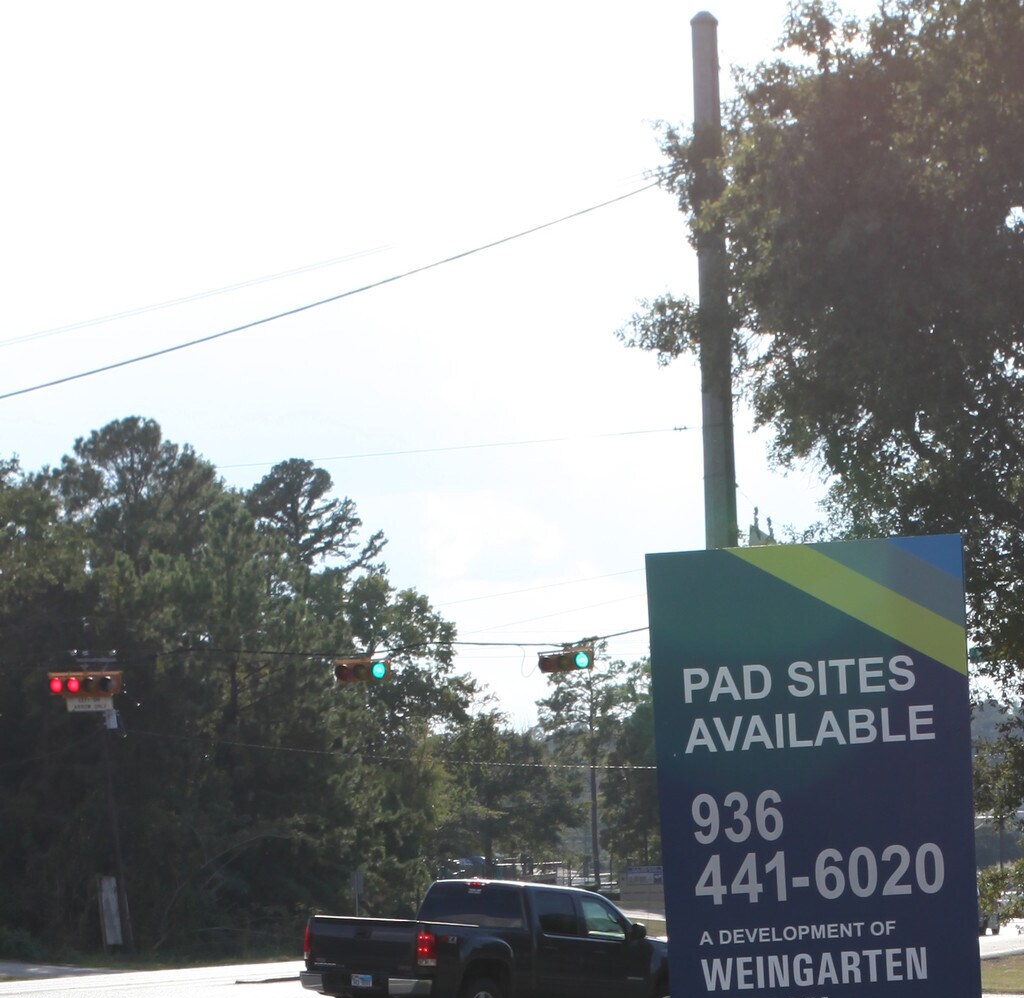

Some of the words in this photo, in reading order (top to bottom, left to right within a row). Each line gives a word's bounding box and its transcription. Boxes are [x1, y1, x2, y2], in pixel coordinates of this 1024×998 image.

[683, 664, 772, 704] PAD
[787, 655, 916, 698] SITES
[684, 704, 937, 754] AVAILABLE
[691, 789, 784, 845] 936
[695, 842, 946, 905] 441-6020
[699, 930, 714, 946] A
[718, 922, 866, 945] DEVELOPMENT
[870, 920, 897, 937] OF
[700, 946, 928, 992] WEINGARTEN
